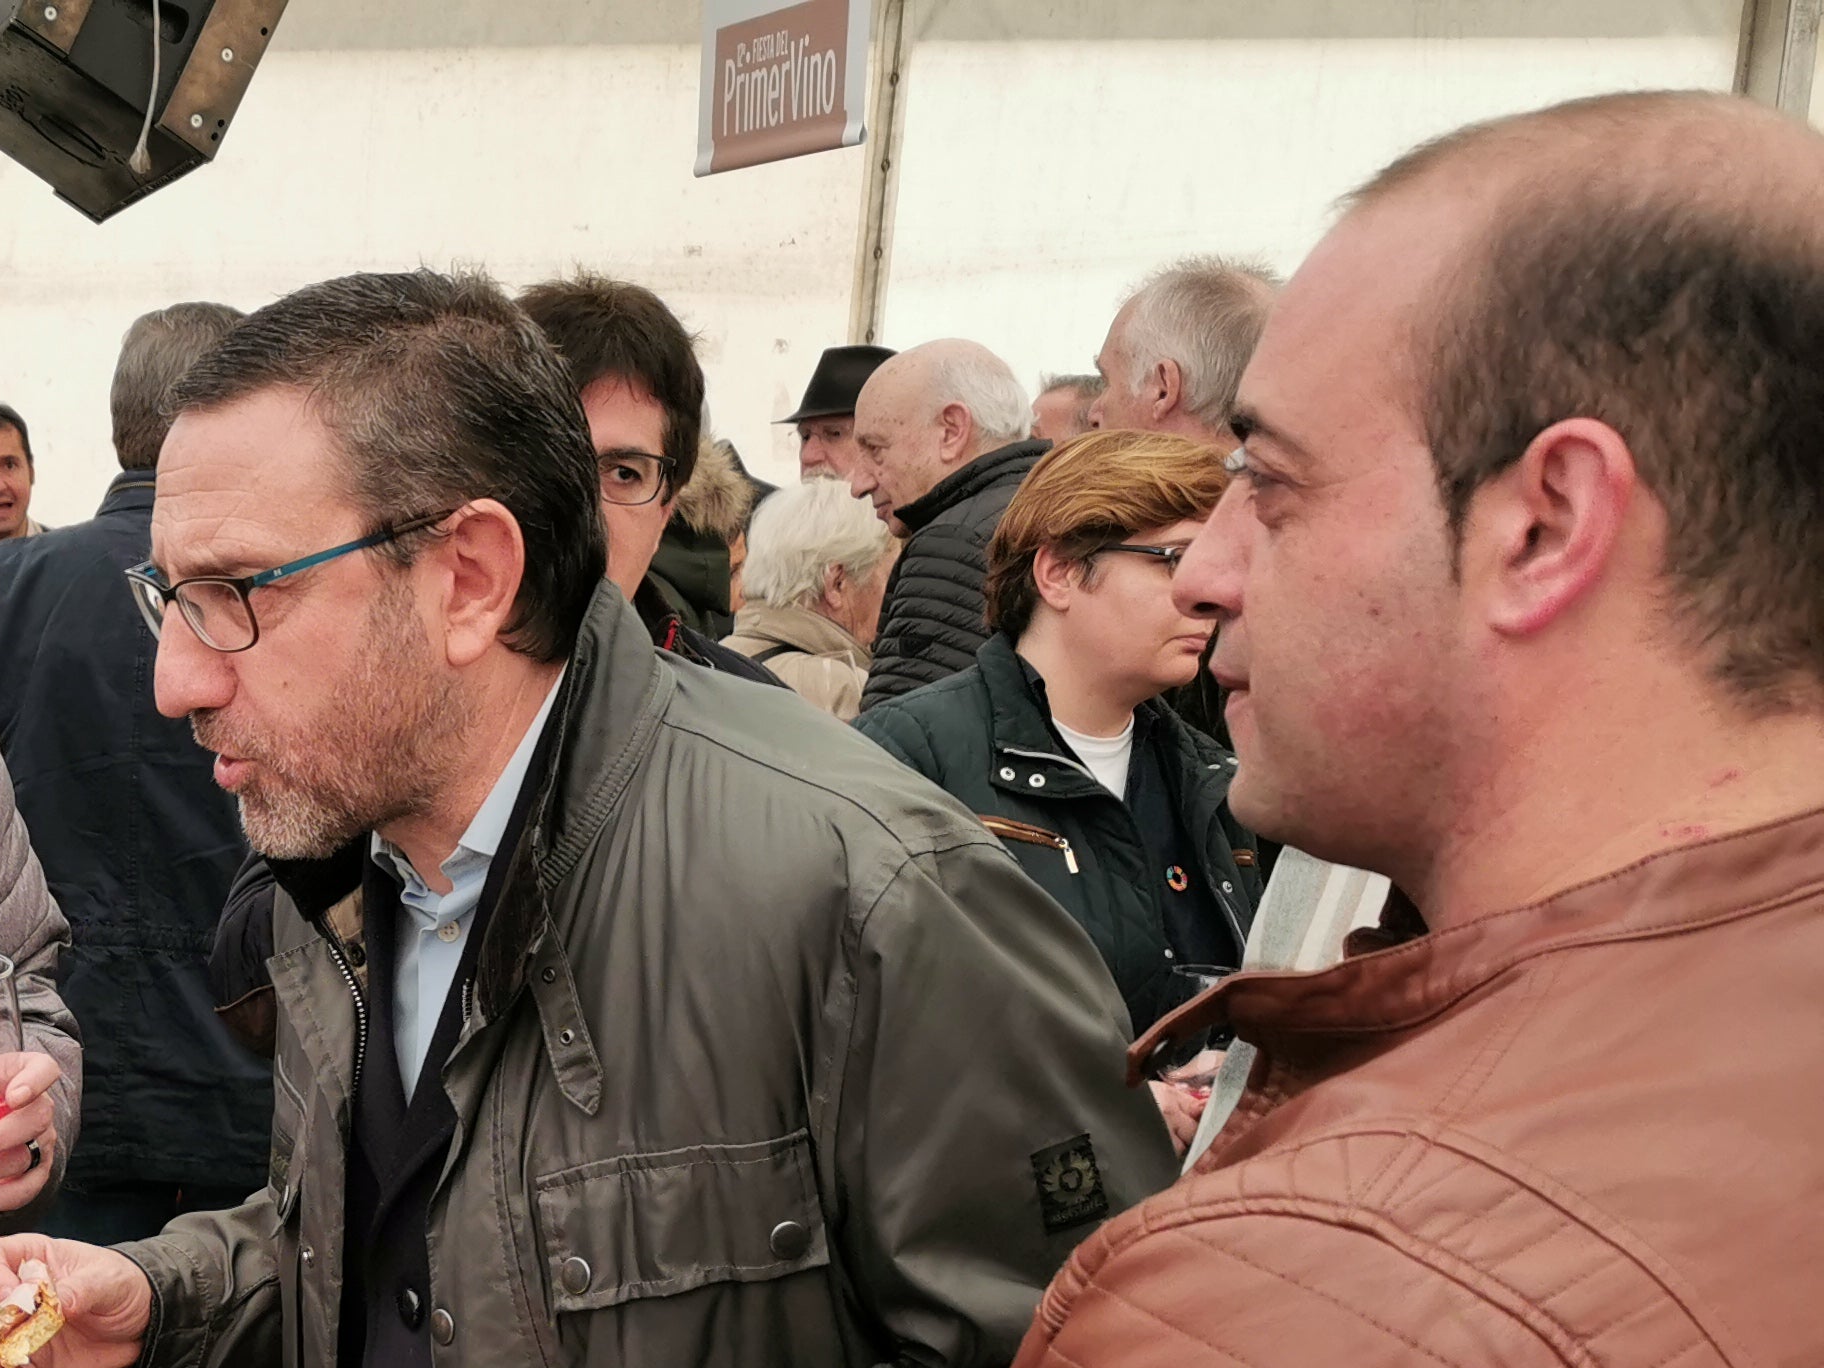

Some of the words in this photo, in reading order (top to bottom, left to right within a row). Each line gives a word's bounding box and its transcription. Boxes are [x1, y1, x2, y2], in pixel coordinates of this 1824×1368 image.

[752, 33, 775, 64] FIESTA
[776, 29, 789, 57] DEL
[722, 33, 836, 137] PrimerVino
